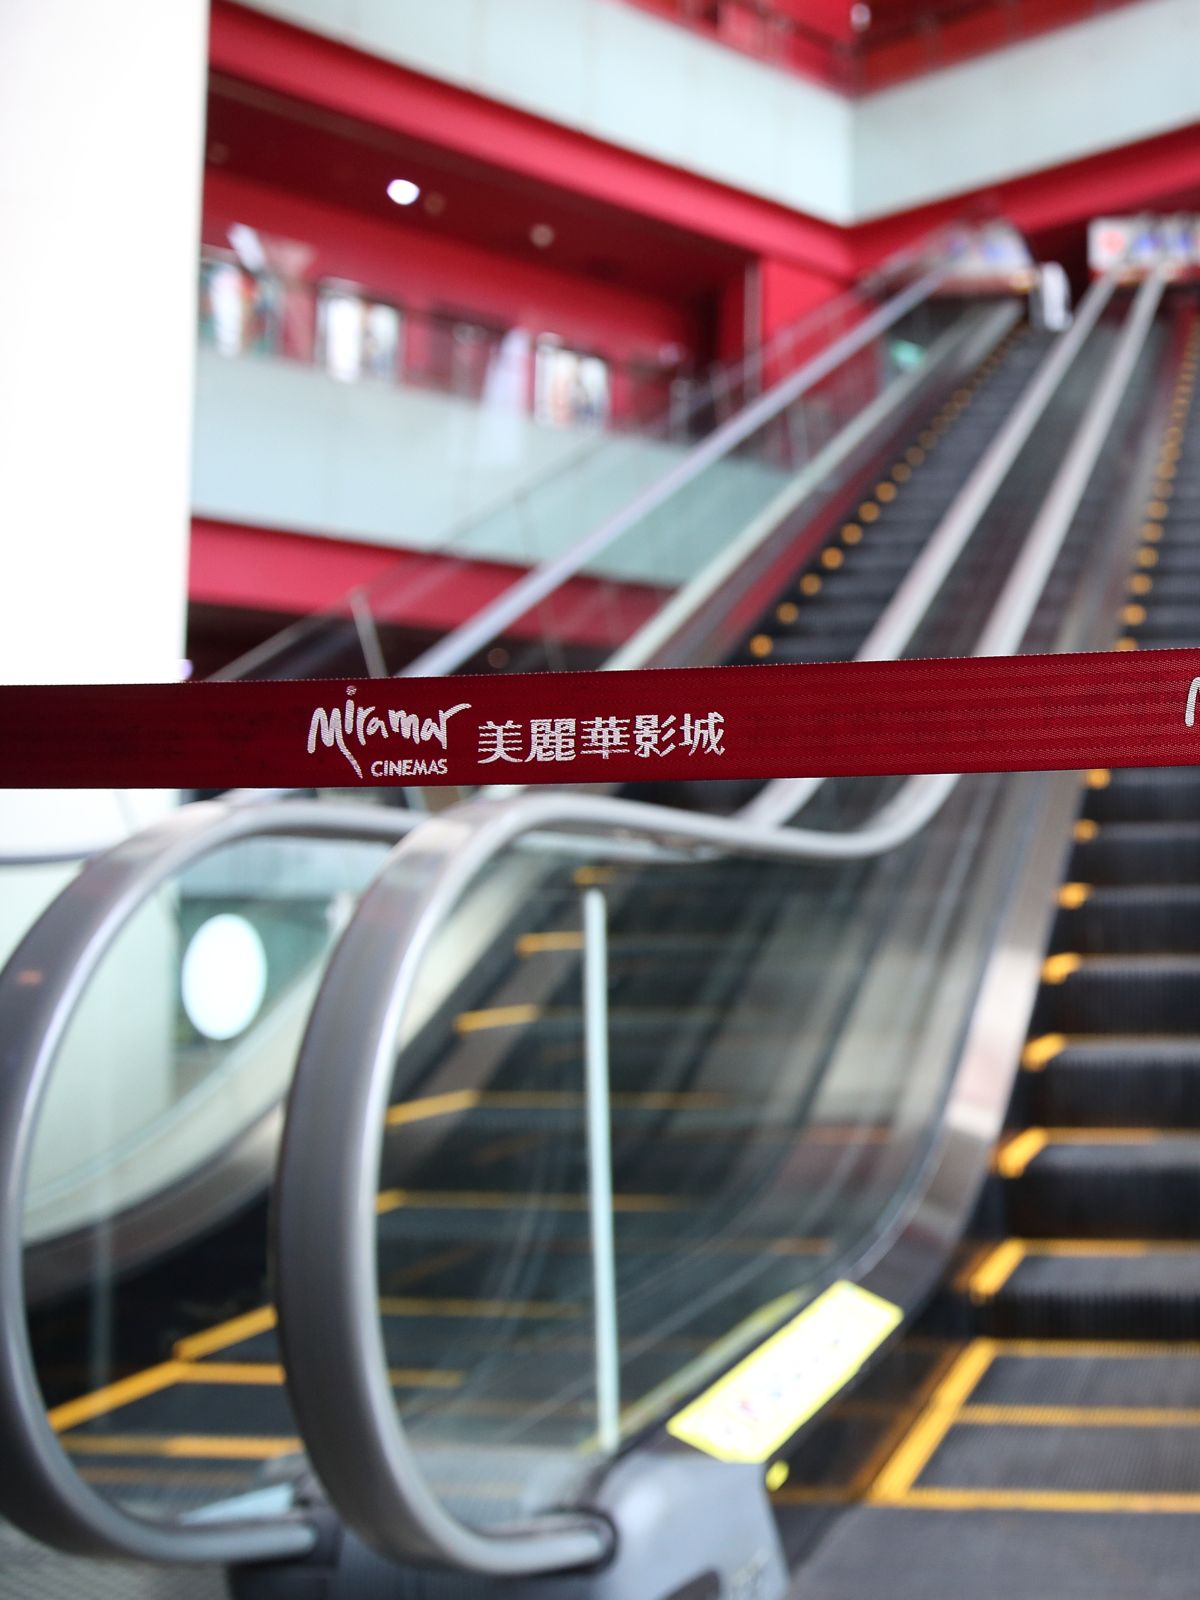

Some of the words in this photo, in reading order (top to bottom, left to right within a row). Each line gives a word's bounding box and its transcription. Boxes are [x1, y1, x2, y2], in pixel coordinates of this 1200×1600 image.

[307, 685, 472, 779] Miramar
[477, 711, 726, 764] 美麗華影城
[370, 758, 448, 776] CINEMAS
